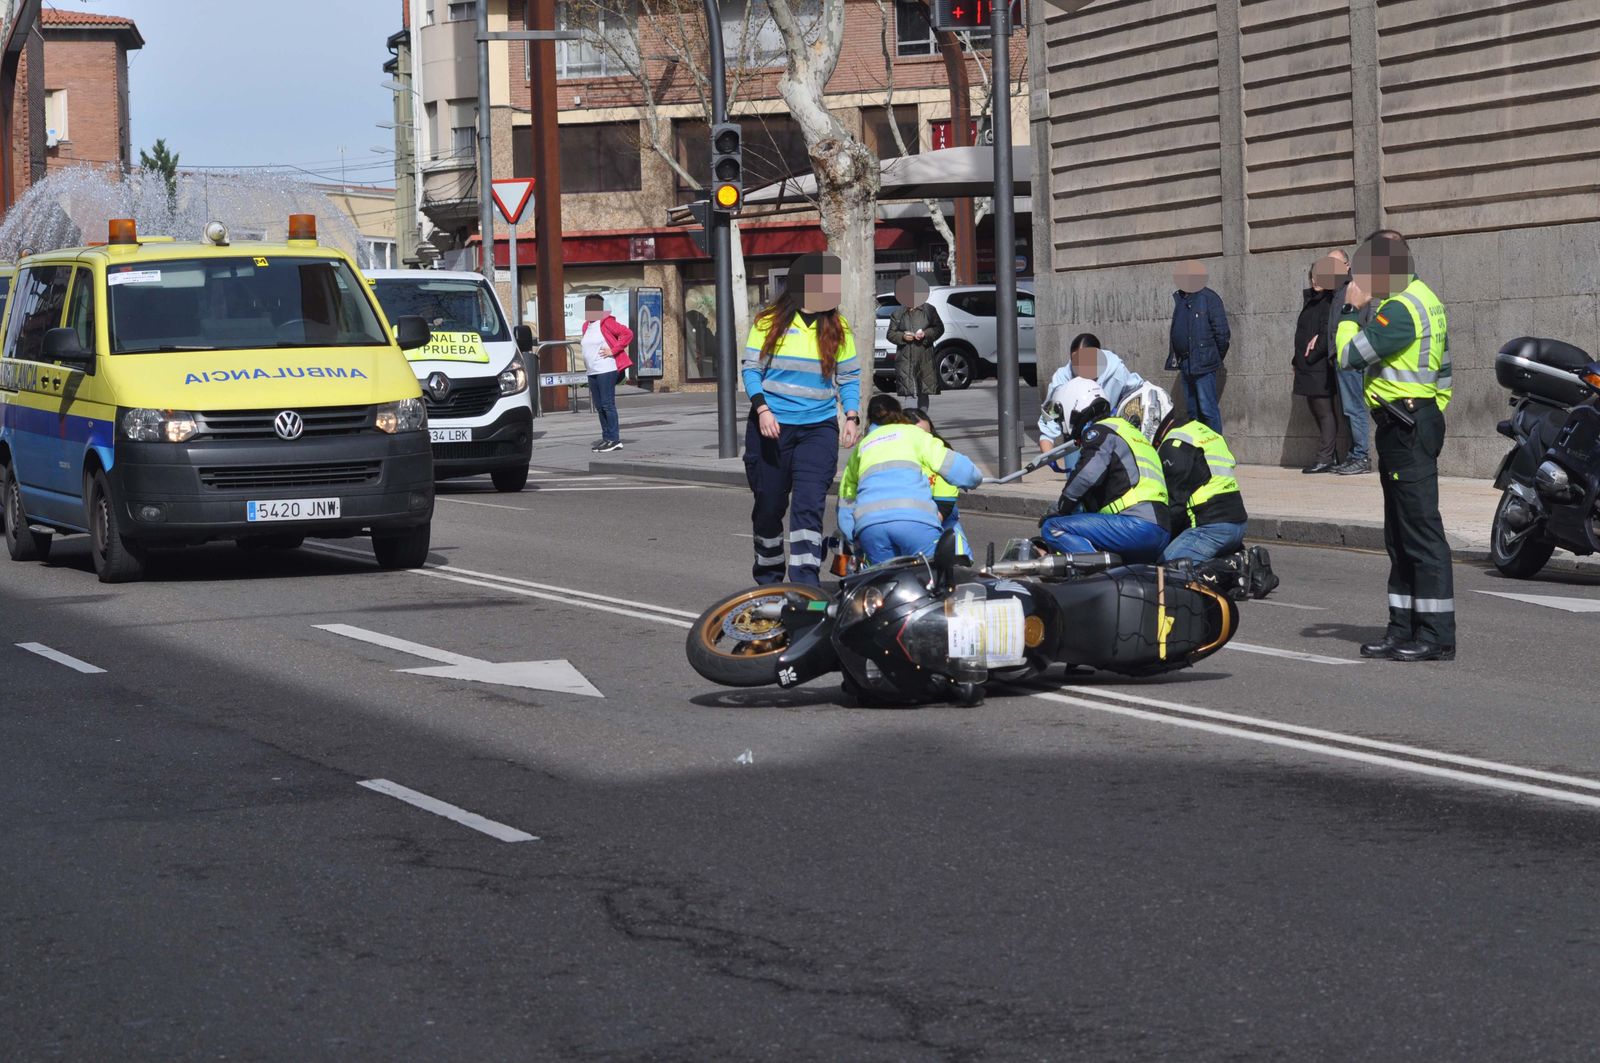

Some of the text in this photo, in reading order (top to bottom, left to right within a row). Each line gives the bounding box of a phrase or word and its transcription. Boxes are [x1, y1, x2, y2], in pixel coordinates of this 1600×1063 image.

[431, 334, 479, 343] NAL DE
[423, 345, 477, 354] PRUEBA
[429, 430, 468, 441] 34 LBK
[259, 501, 336, 518] 5420 JNW
